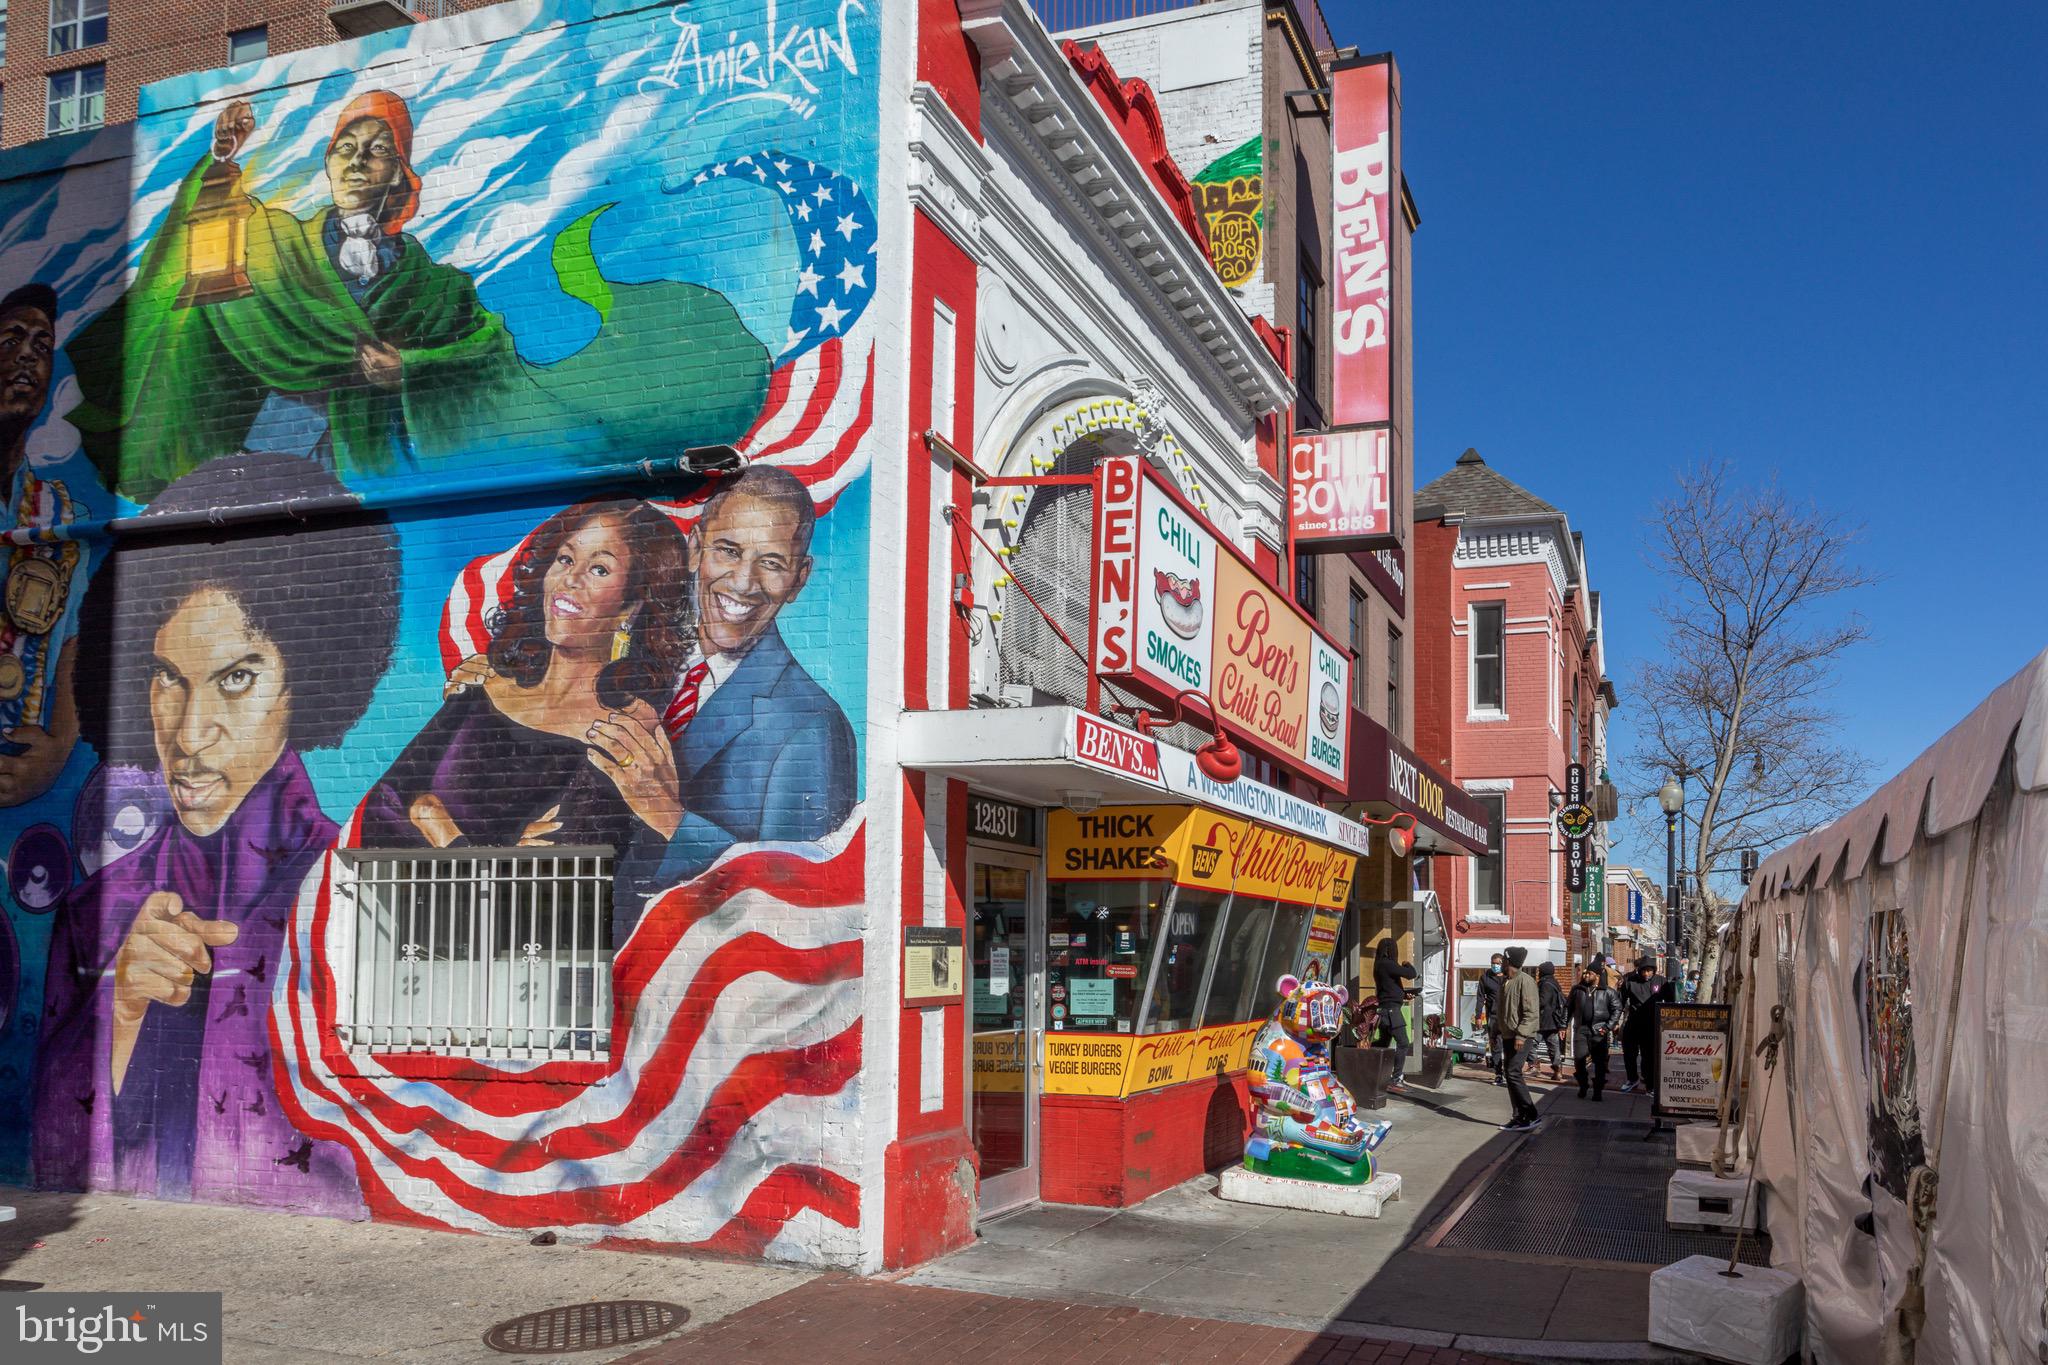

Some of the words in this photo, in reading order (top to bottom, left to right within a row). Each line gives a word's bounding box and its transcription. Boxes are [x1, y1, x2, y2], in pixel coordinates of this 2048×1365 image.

[1212, 237, 1256, 261] DOGS
[1334, 133, 1389, 356] BEN'S
[1292, 437, 1386, 480] CHILI
[1293, 477, 1388, 516] BOWL
[1158, 507, 1201, 569] CHILI
[1298, 521, 1328, 530] since
[1328, 515, 1375, 532] 1958
[1101, 459, 1134, 669] BEN'S
[1227, 589, 1298, 694] Ben's
[1146, 630, 1202, 688] SMOKES
[1319, 649, 1341, 685] CHILI
[1218, 662, 1258, 726] Chili
[1259, 690, 1302, 749] Bowl
[1311, 735, 1341, 771] BURGER
[1571, 768, 1579, 802] RUSH
[1187, 761, 1198, 790] A
[1200, 774, 1277, 818] WASHINGTON
[1278, 796, 1329, 836] LANDMARK
[1338, 820, 1358, 846] SINCE
[1419, 772, 1444, 821] DOOR
[1445, 805, 1474, 839] RESTAURANT
[1478, 826, 1488, 845] BAR
[1559, 803, 1580, 818] BLENDED
[1580, 804, 1593, 817] FRUIT
[1077, 814, 1155, 839] THICK
[1065, 845, 1169, 872] SHAKES
[1230, 822, 1290, 882] Chili
[1284, 840, 1336, 892] Bowl
[1570, 842, 1583, 886] BOWLS
[1588, 873, 1596, 911] SALOON
[1171, 911, 1195, 936] OPEN
[1075, 958, 1088, 966] ATM
[1660, 1008, 1680, 1017] OPEN
[1682, 1009, 1697, 1018] FOR
[1049, 1042, 1081, 1057] TURKEY
[1083, 1043, 1122, 1057] BURGERS
[1152, 1035, 1185, 1060] Chili
[1208, 1028, 1237, 1051] Chili
[1049, 1060, 1079, 1075] VEGGIE
[1081, 1061, 1122, 1076] BURGERS
[1147, 1064, 1174, 1084] BOWL
[1206, 1053, 1229, 1071] DOGS
[1663, 1077, 1710, 1085] BOTTOMLESS
